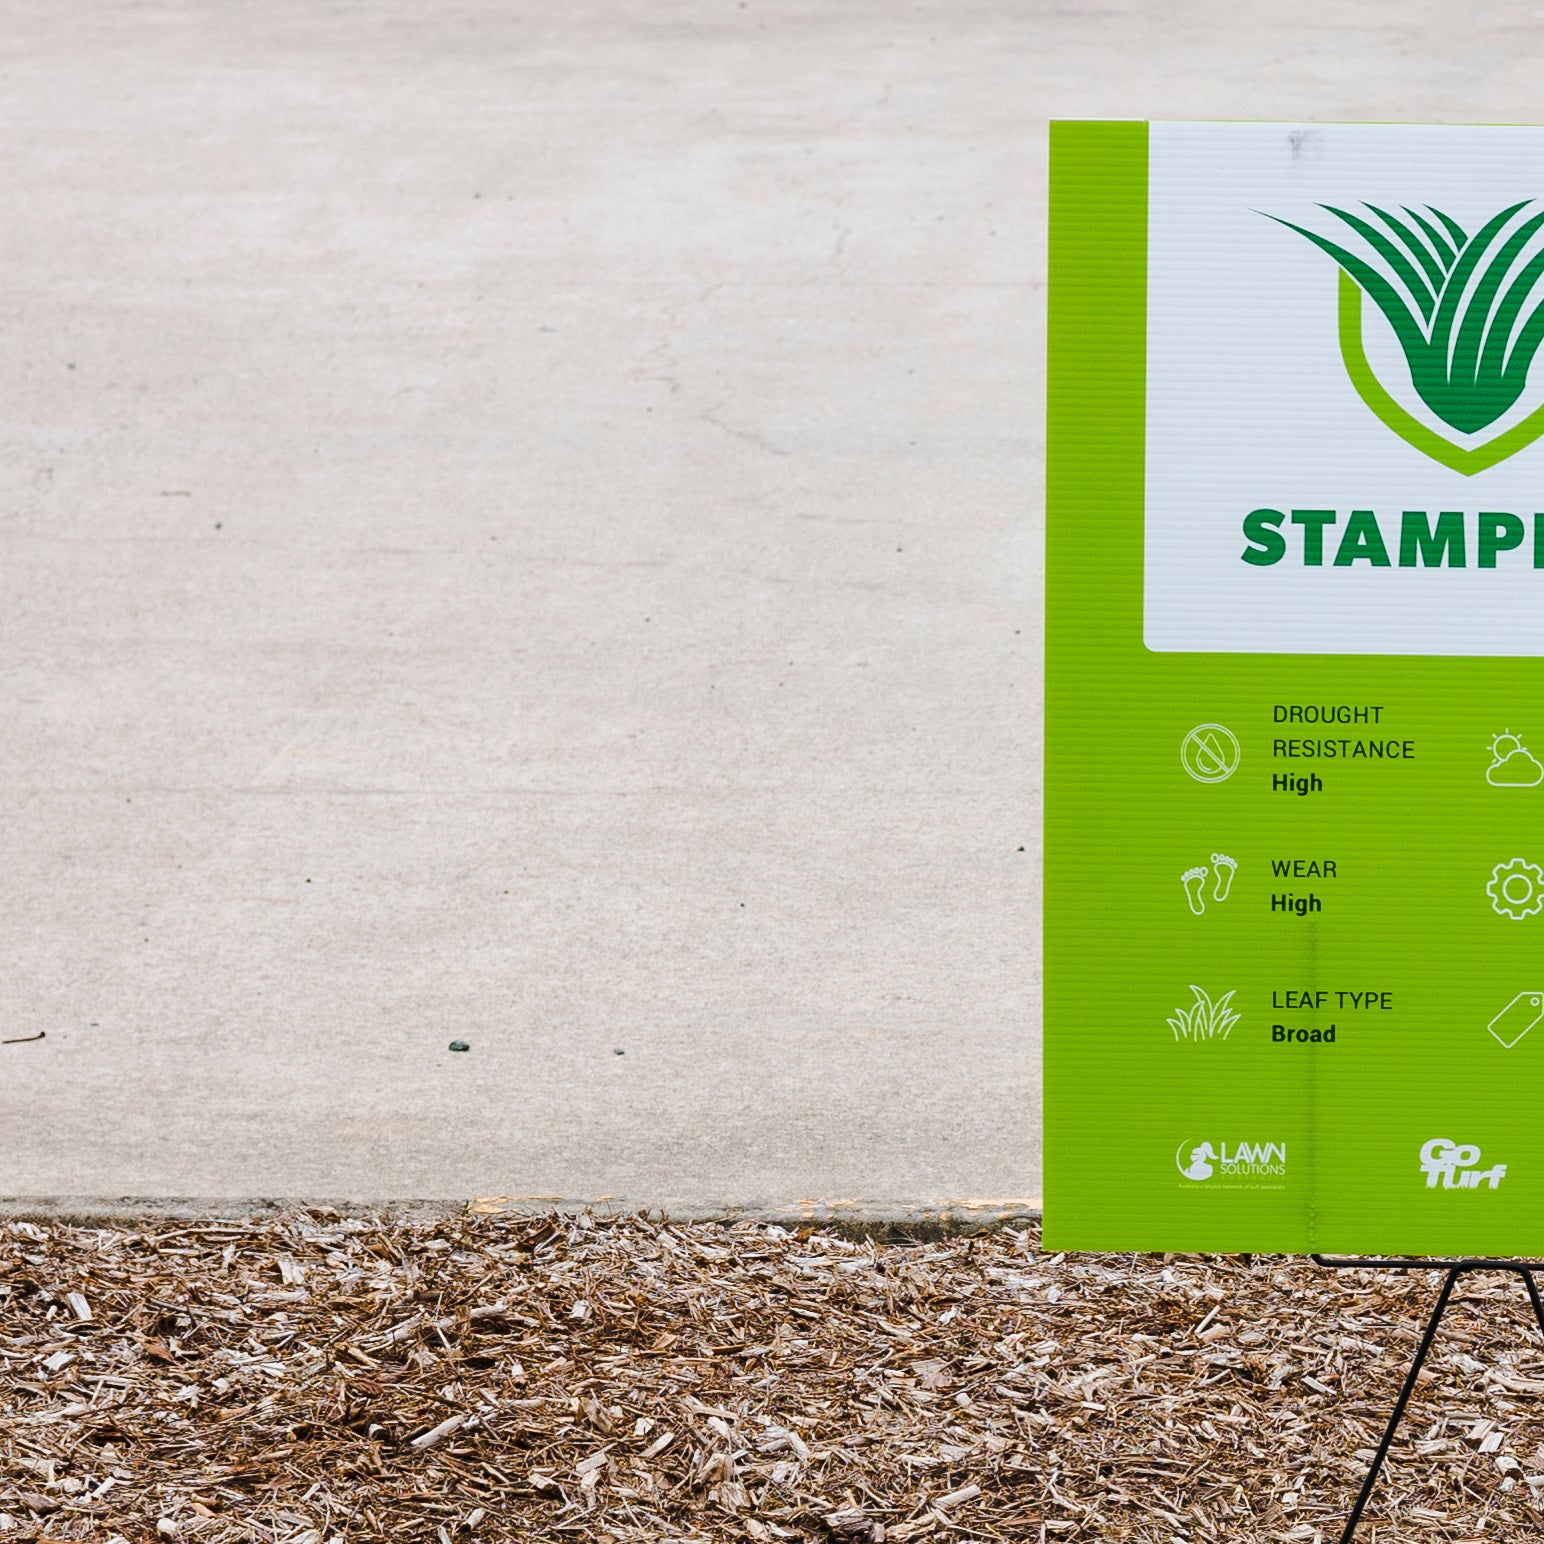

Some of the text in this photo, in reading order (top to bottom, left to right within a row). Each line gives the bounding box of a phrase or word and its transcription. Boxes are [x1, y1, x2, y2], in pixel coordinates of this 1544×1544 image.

[1273, 704, 1384, 725] DROUGHT
[1273, 738, 1415, 759] RESISTANCE
[1272, 772, 1323, 797] High
[1271, 859, 1337, 879] WEAR
[1271, 892, 1322, 917] High
[1272, 990, 1393, 1010] LEAF TYPE
[1271, 1023, 1336, 1043] Broad
[1221, 1142, 1286, 1164] LAWN
[1419, 1138, 1481, 1167] Go
[1220, 1163, 1286, 1175] SOLUTIONS
[1419, 1163, 1508, 1190] Turf
